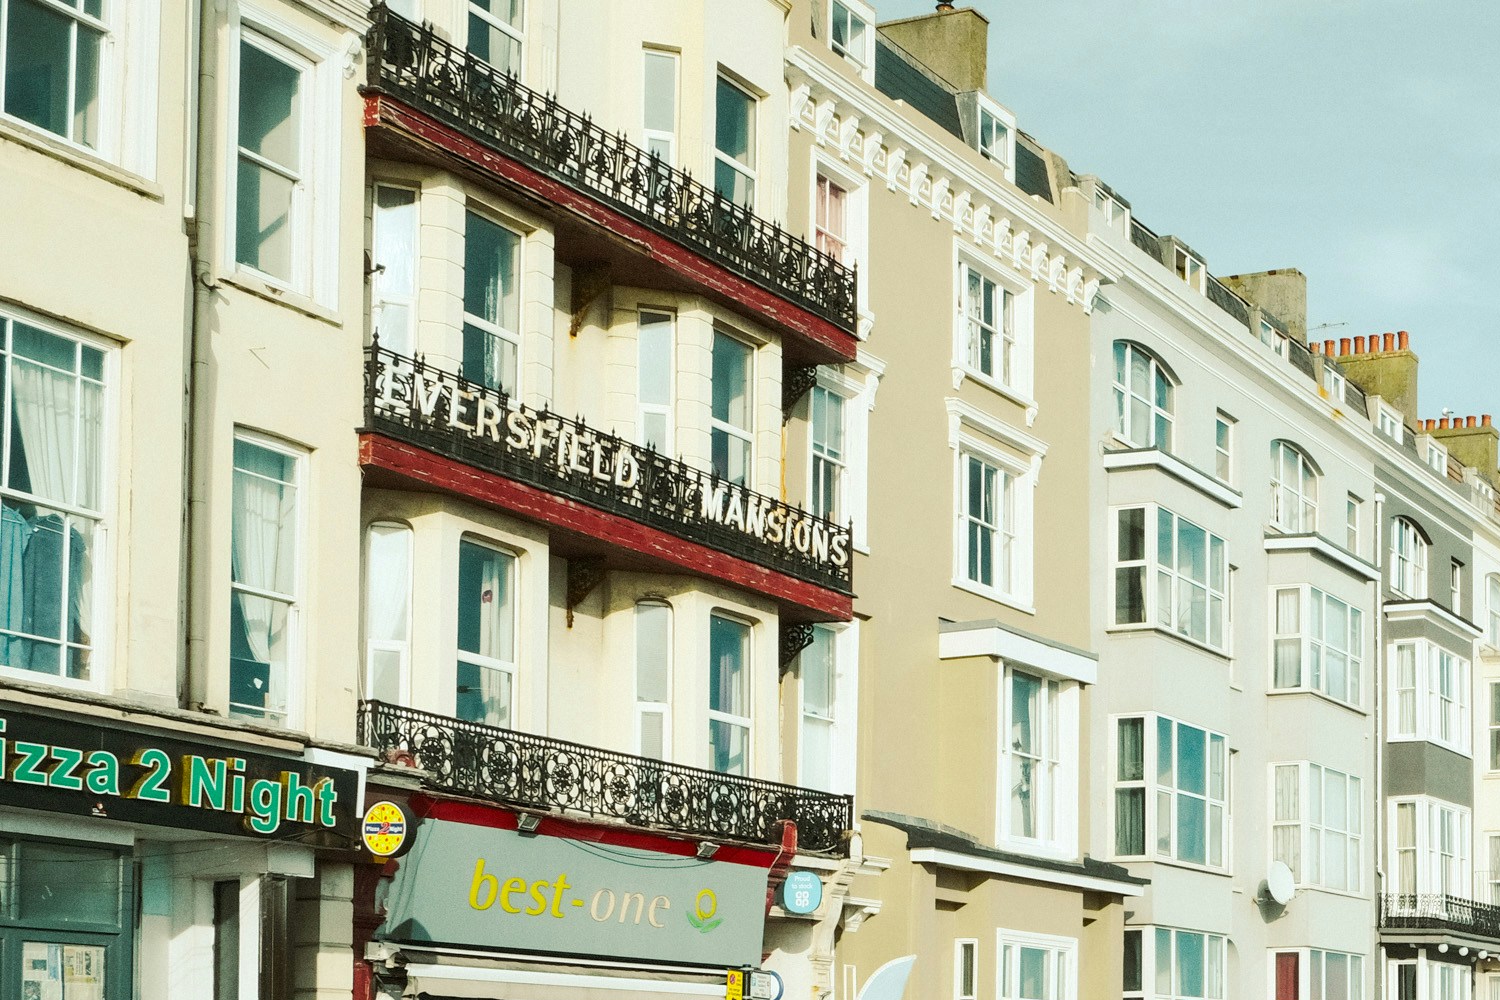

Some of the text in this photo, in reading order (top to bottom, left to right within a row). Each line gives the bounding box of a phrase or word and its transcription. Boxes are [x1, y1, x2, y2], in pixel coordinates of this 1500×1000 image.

[375, 358, 849, 566] EVERSFIELD MANSIONS
[138, 749, 171, 803] 2
[189, 755, 337, 834] Night
[377, 821, 390, 835] 2
[468, 857, 672, 928] best-one
